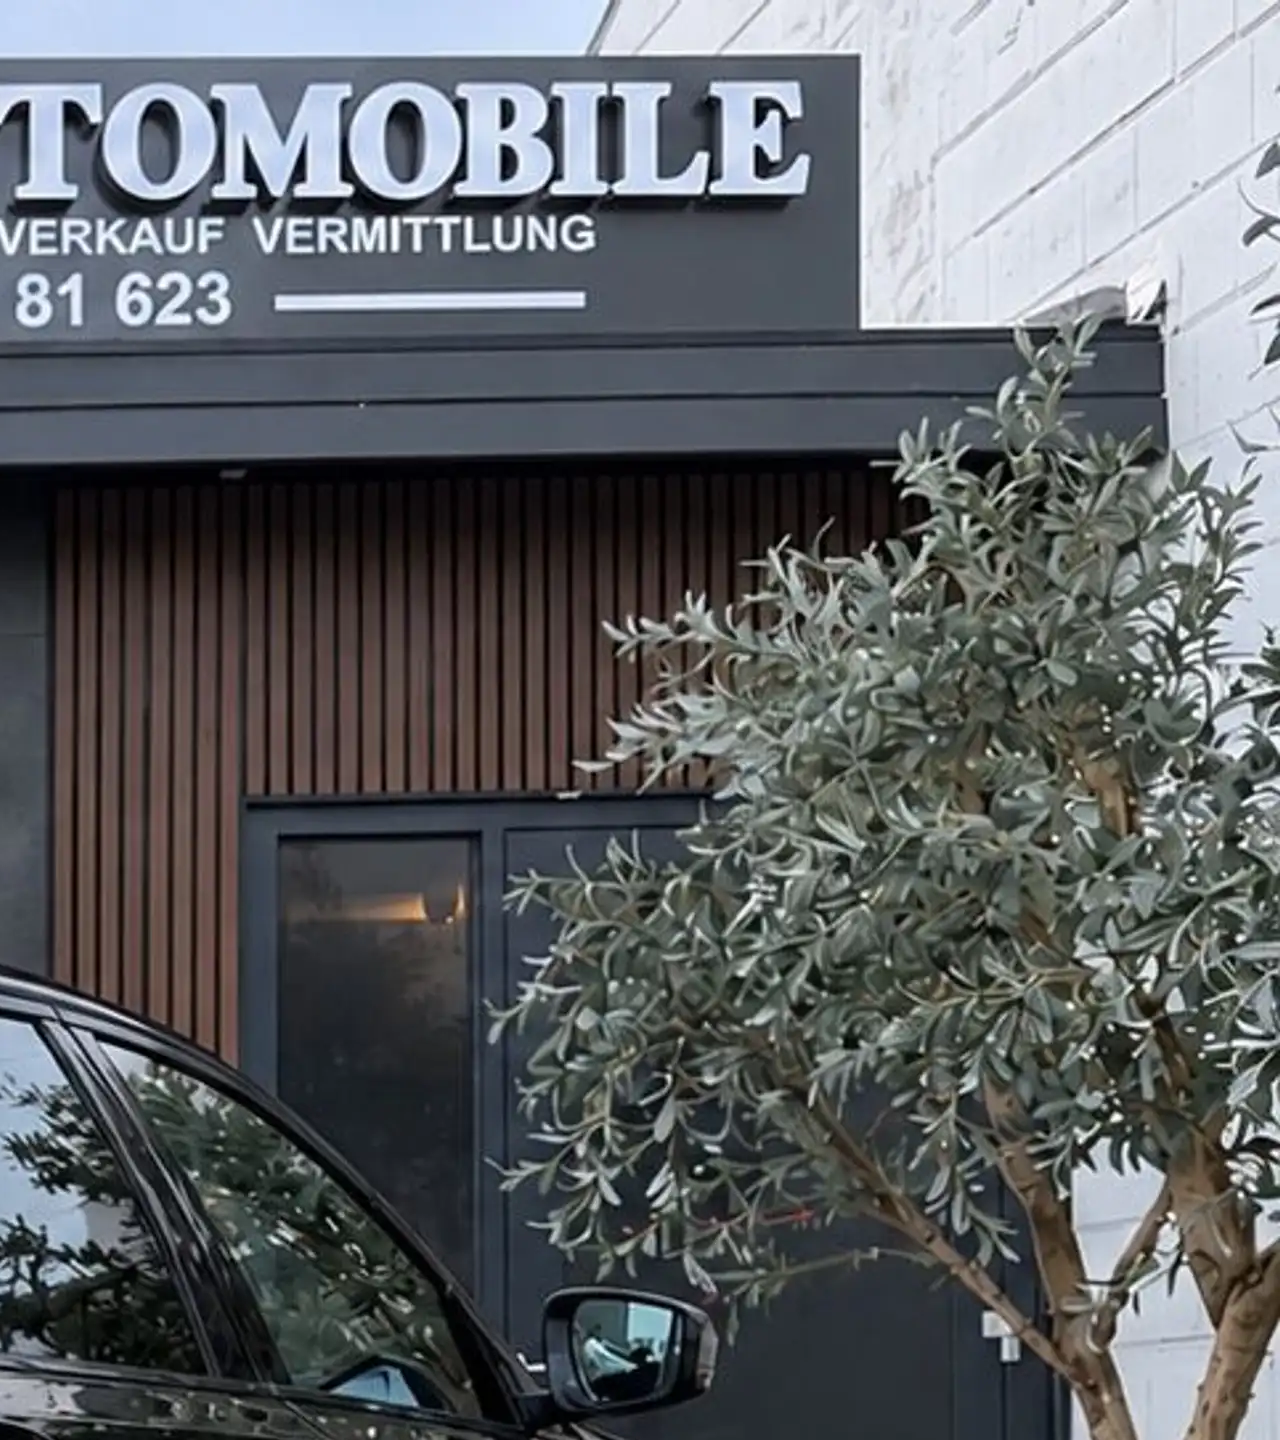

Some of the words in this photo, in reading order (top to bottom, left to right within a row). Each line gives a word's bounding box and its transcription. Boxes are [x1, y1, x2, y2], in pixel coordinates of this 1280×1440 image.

[251, 213, 597, 255] VERMITTLUNG
[15, 272, 84, 327] 81
[115, 270, 232, 327] 623
